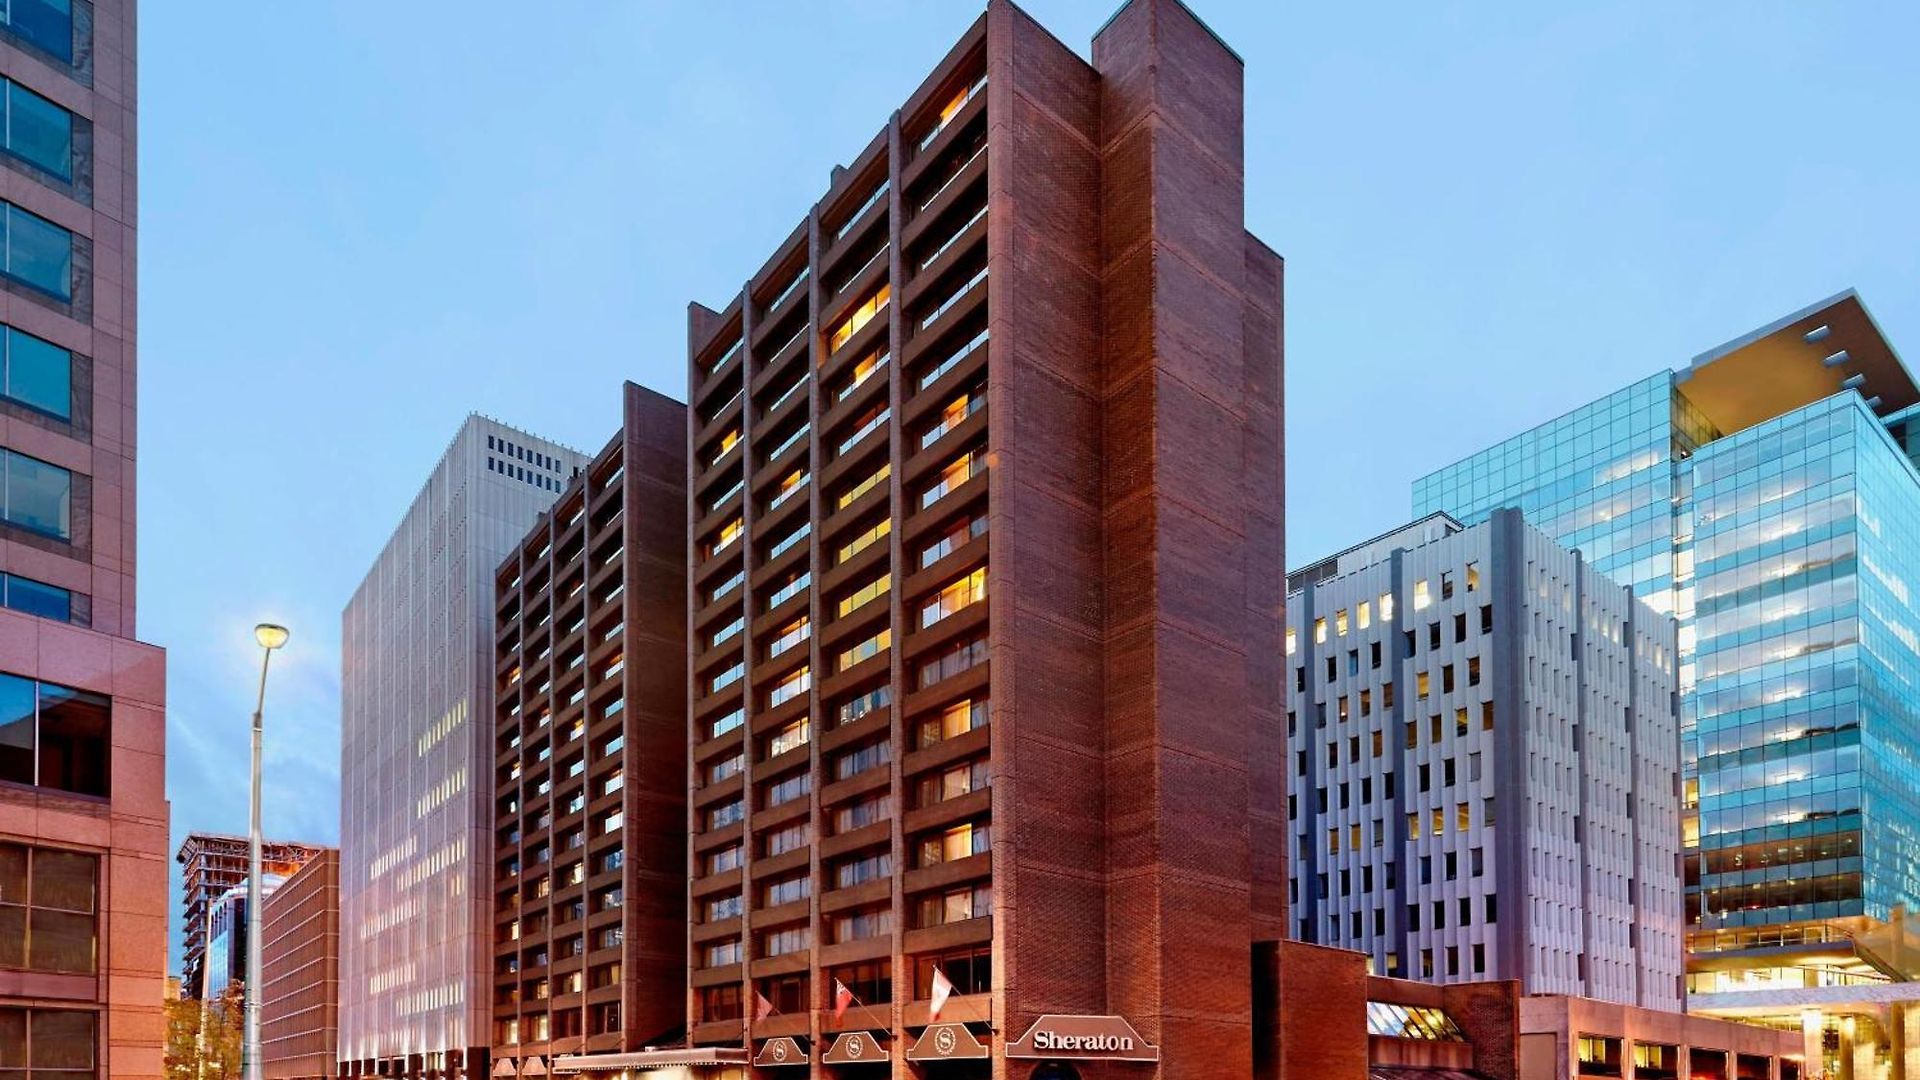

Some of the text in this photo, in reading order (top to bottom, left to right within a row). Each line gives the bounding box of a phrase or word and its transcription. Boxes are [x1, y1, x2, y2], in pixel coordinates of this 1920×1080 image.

[850, 1039, 860, 1054] S
[940, 1032, 951, 1049] S
[1034, 1030, 1134, 1050] Sheraton
